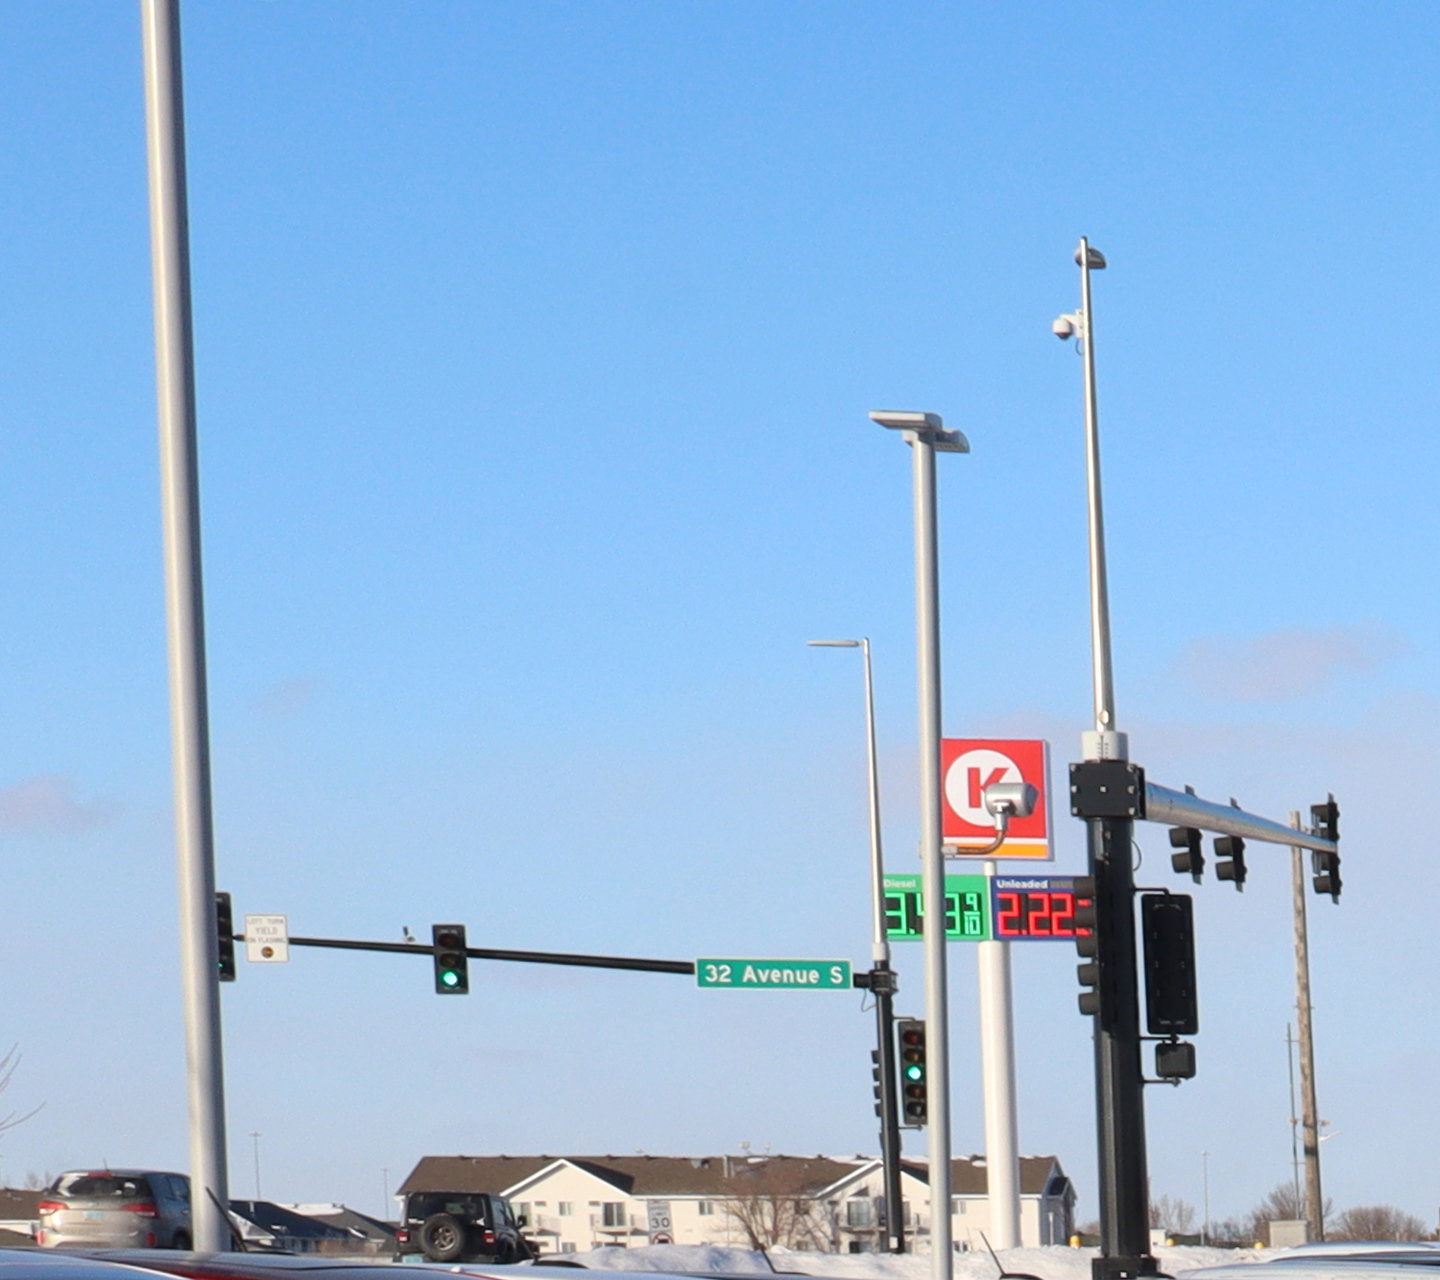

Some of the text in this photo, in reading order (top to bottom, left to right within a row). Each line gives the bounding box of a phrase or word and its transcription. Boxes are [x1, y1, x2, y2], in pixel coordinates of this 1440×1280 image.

[966, 767, 1010, 809] K
[996, 879, 1048, 889] Unleaded
[705, 964, 844, 985] 32 Avenue S
[651, 1217, 670, 1229] 30
